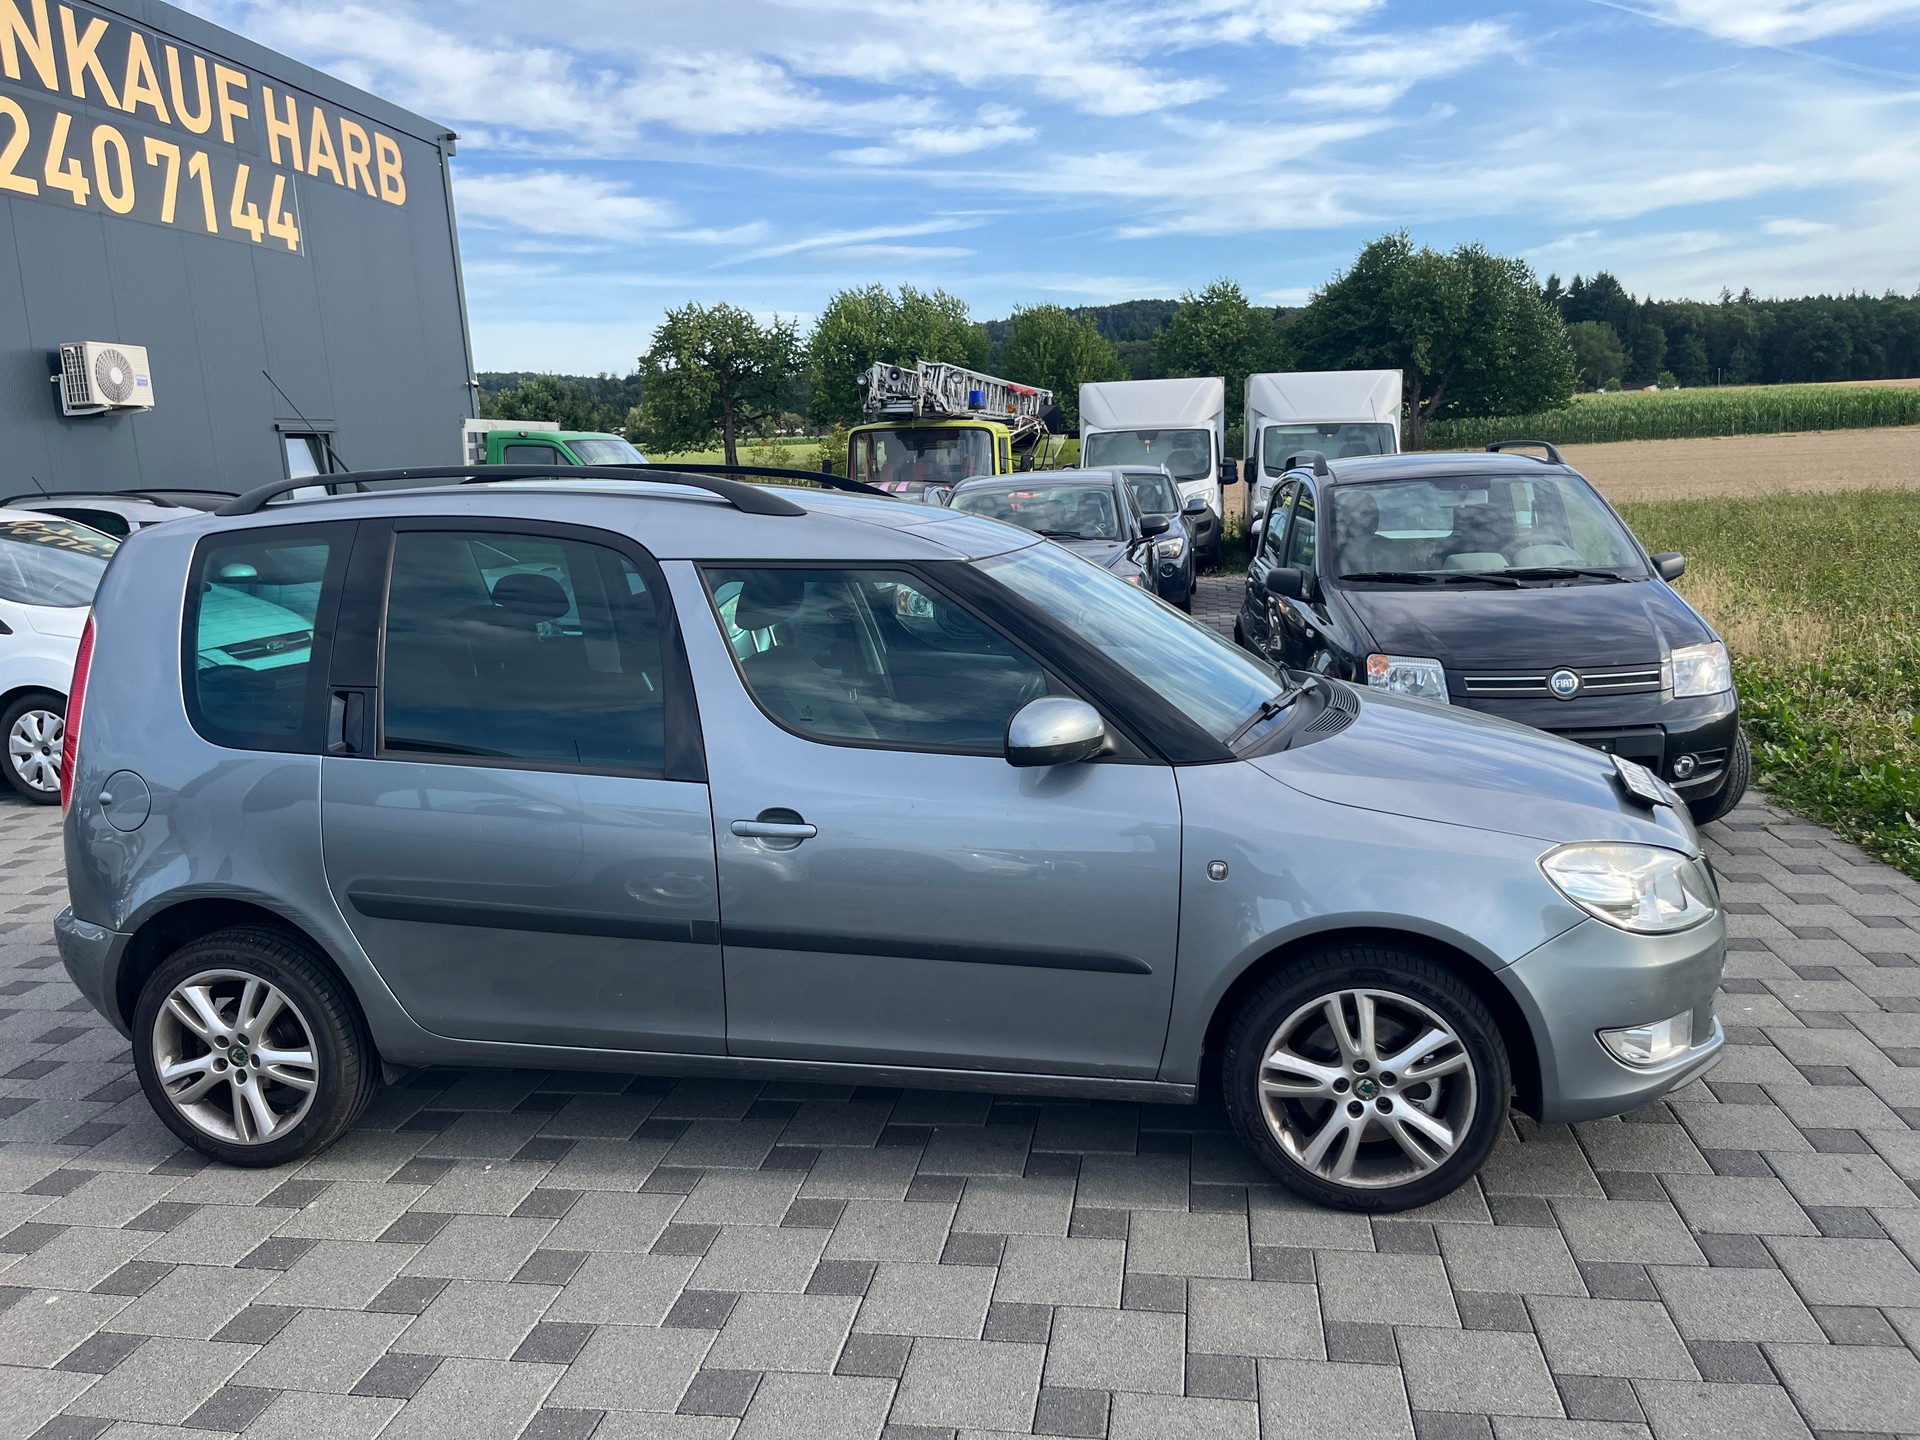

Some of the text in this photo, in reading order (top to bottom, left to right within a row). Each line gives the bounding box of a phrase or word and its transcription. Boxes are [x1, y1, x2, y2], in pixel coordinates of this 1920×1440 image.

[0, 0, 407, 206] NKAUF HARB
[1556, 679, 1573, 688] FIAT
[1407, 979, 1466, 1020] NEXEN
